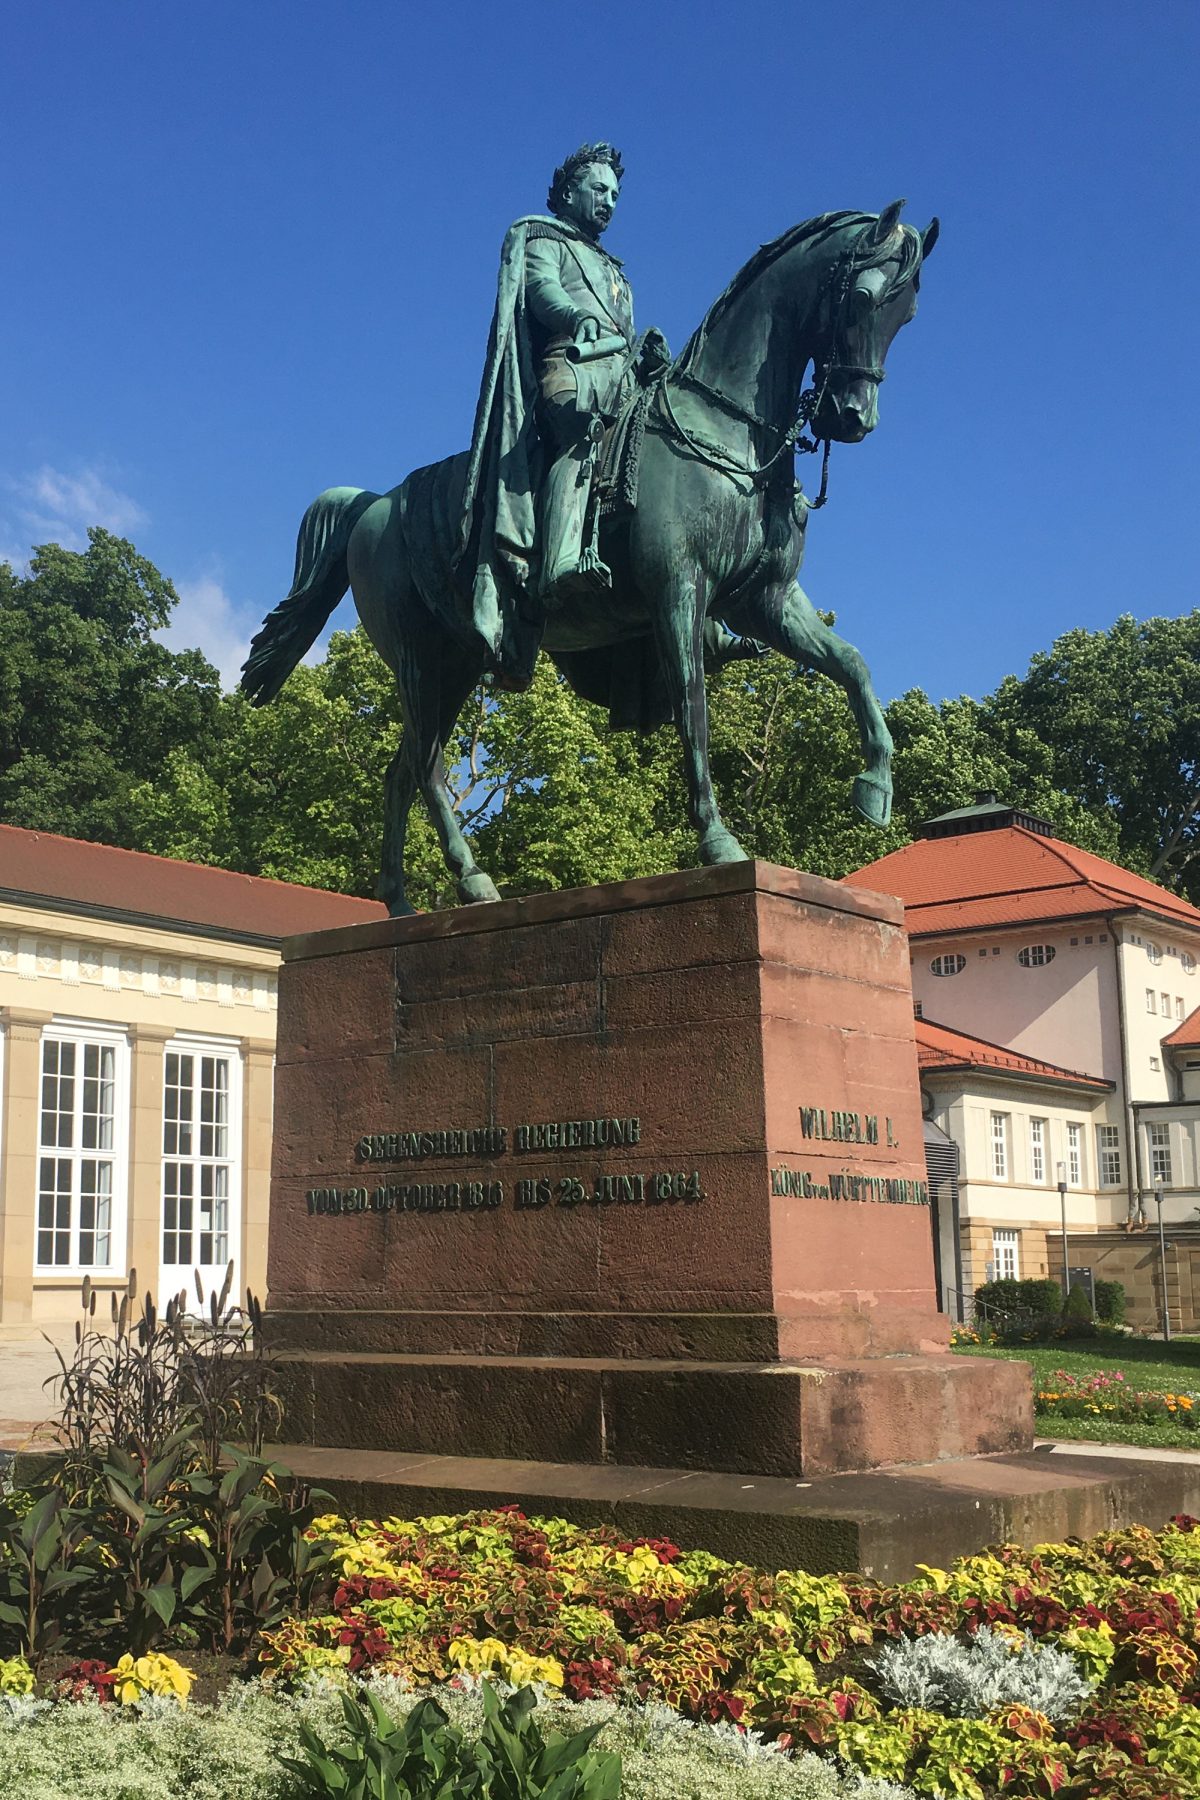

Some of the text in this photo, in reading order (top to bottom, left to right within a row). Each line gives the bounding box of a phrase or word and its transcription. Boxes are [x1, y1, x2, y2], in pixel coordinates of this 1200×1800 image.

[359, 1117, 641, 1160] SEGENSREICHE REGIERUNG
[798, 1106, 878, 1145] WILHELM
[374, 1184, 462, 1209] OCTOBER
[518, 1178, 552, 1204] BIS
[560, 1176, 590, 1202] 25.
[595, 1173, 645, 1201] JUNI
[653, 1171, 708, 1200] 1864.
[770, 1164, 812, 1198] KÖNIG
